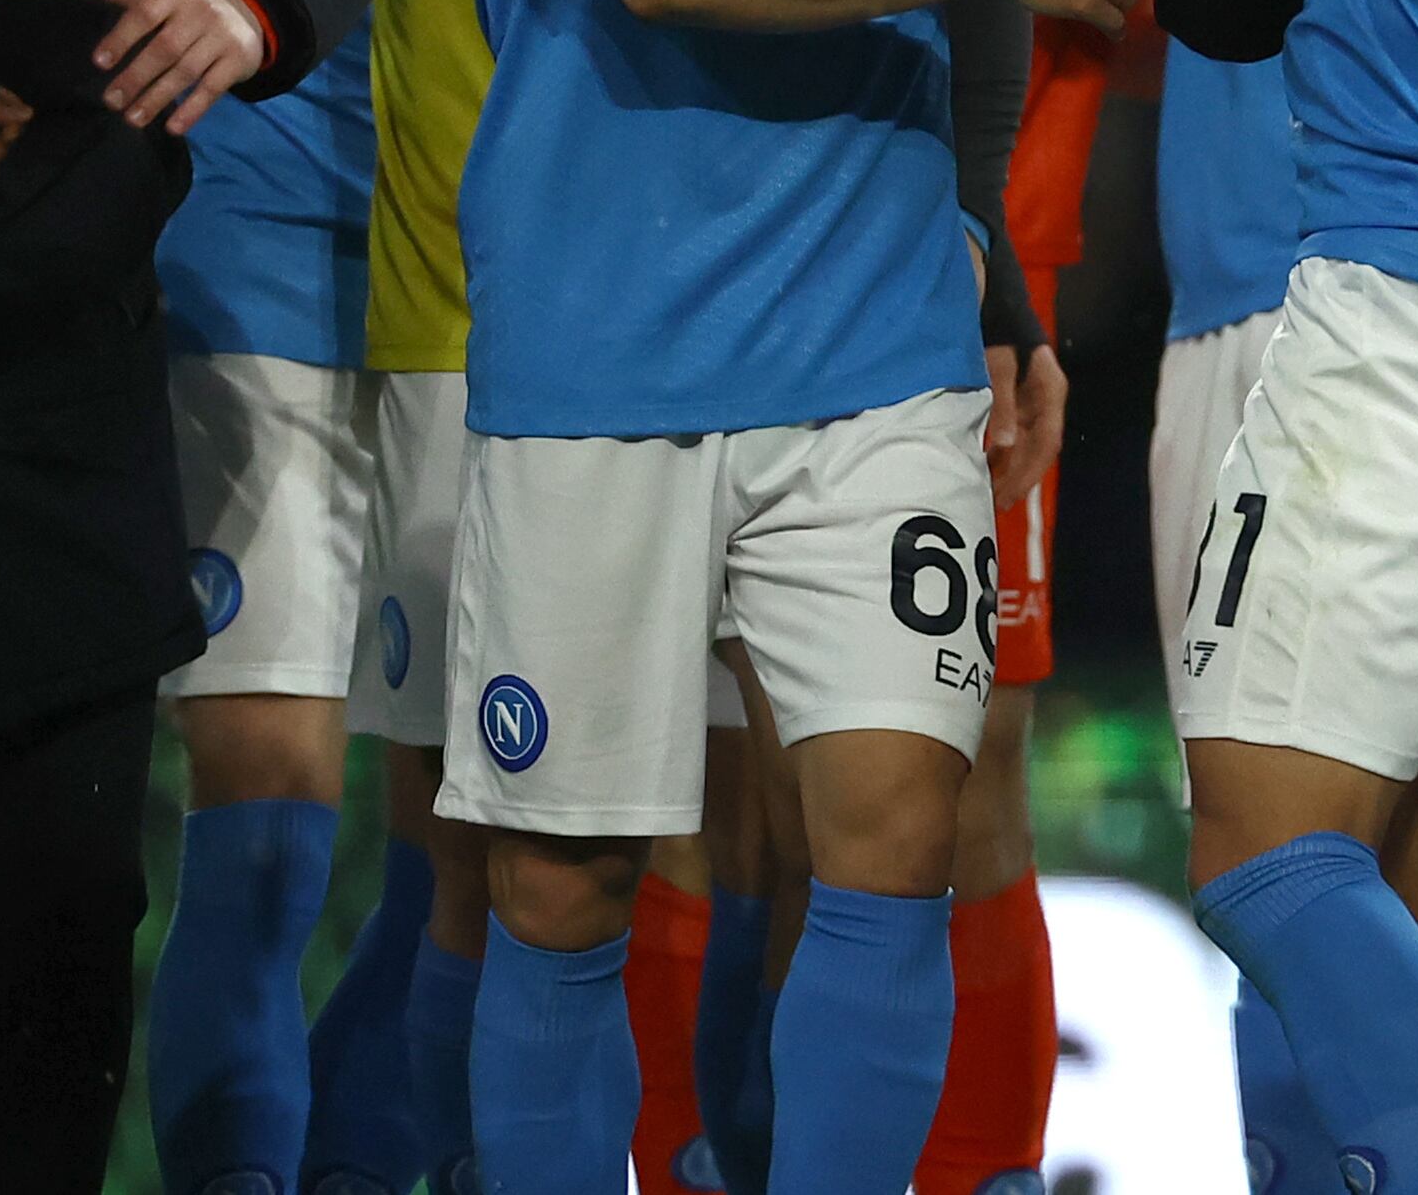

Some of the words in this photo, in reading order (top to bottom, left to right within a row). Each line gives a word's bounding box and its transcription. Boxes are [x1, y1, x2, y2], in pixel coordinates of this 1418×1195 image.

[1186, 492, 1268, 628] 1
[890, 515, 999, 667] 68
[997, 589, 1045, 627] EA
[1183, 640, 1219, 678] A7
[493, 700, 524, 746] N
